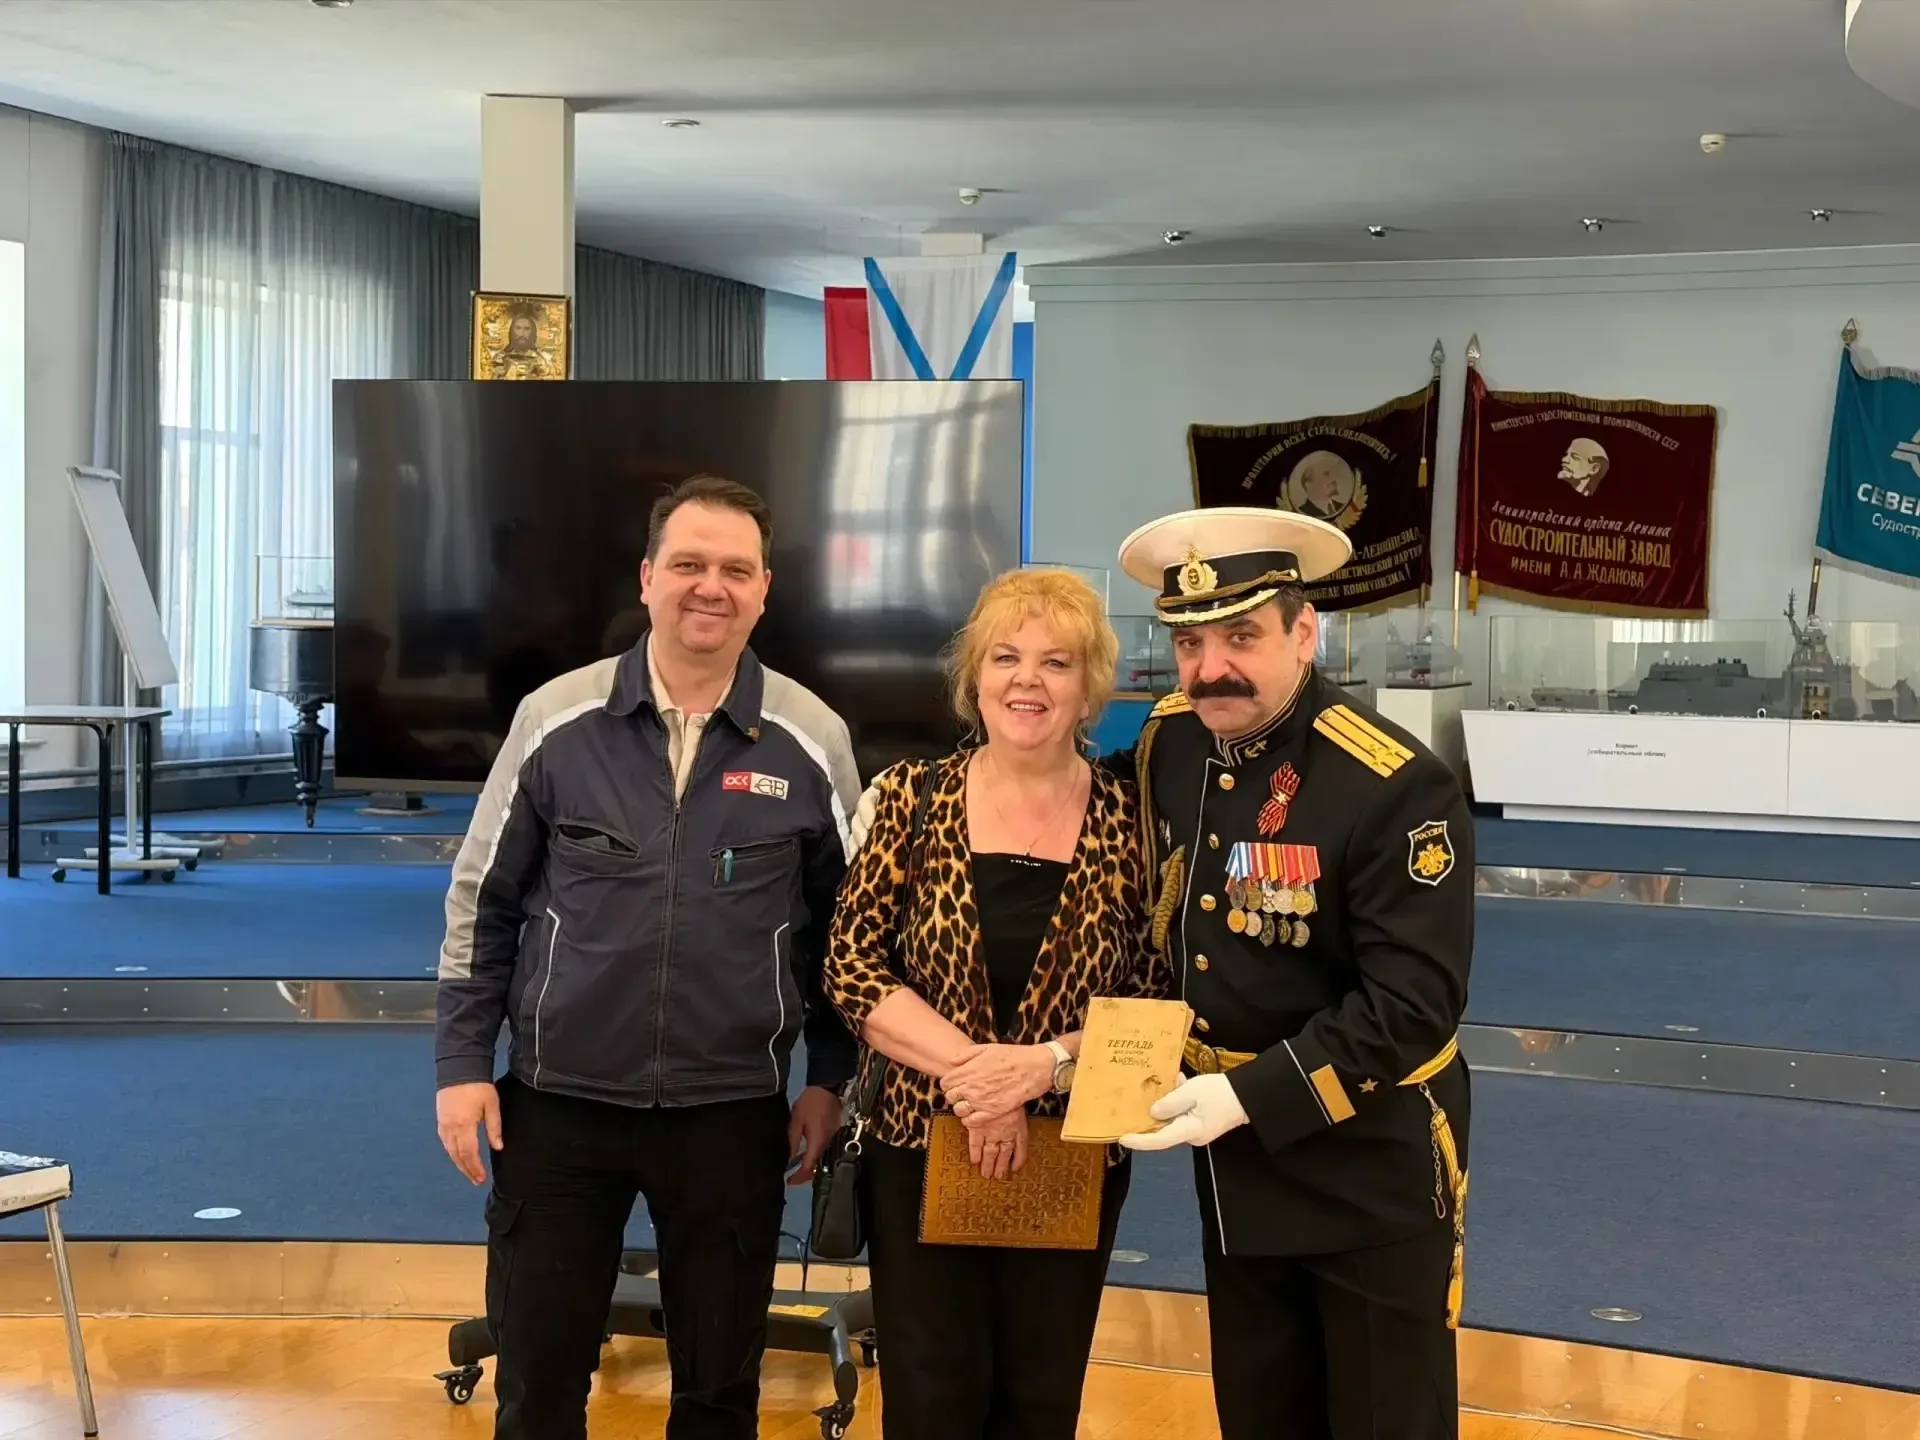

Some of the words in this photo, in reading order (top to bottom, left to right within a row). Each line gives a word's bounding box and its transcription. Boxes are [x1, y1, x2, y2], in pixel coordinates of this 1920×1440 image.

[1492, 500, 1581, 527] Ленинградский
[1583, 515, 1623, 532] ордена
[1624, 520, 1672, 538] Ленина
[1489, 518, 1627, 563] СУДОСТРОИТЕЛЬНЫЙ
[1629, 539, 1672, 568] ЗАВОД
[1510, 556, 1551, 577] ИМЕНИ
[1414, 826, 1444, 842] РОССИЯ
[1108, 1039, 1154, 1051] ТЕТРАДЬ
